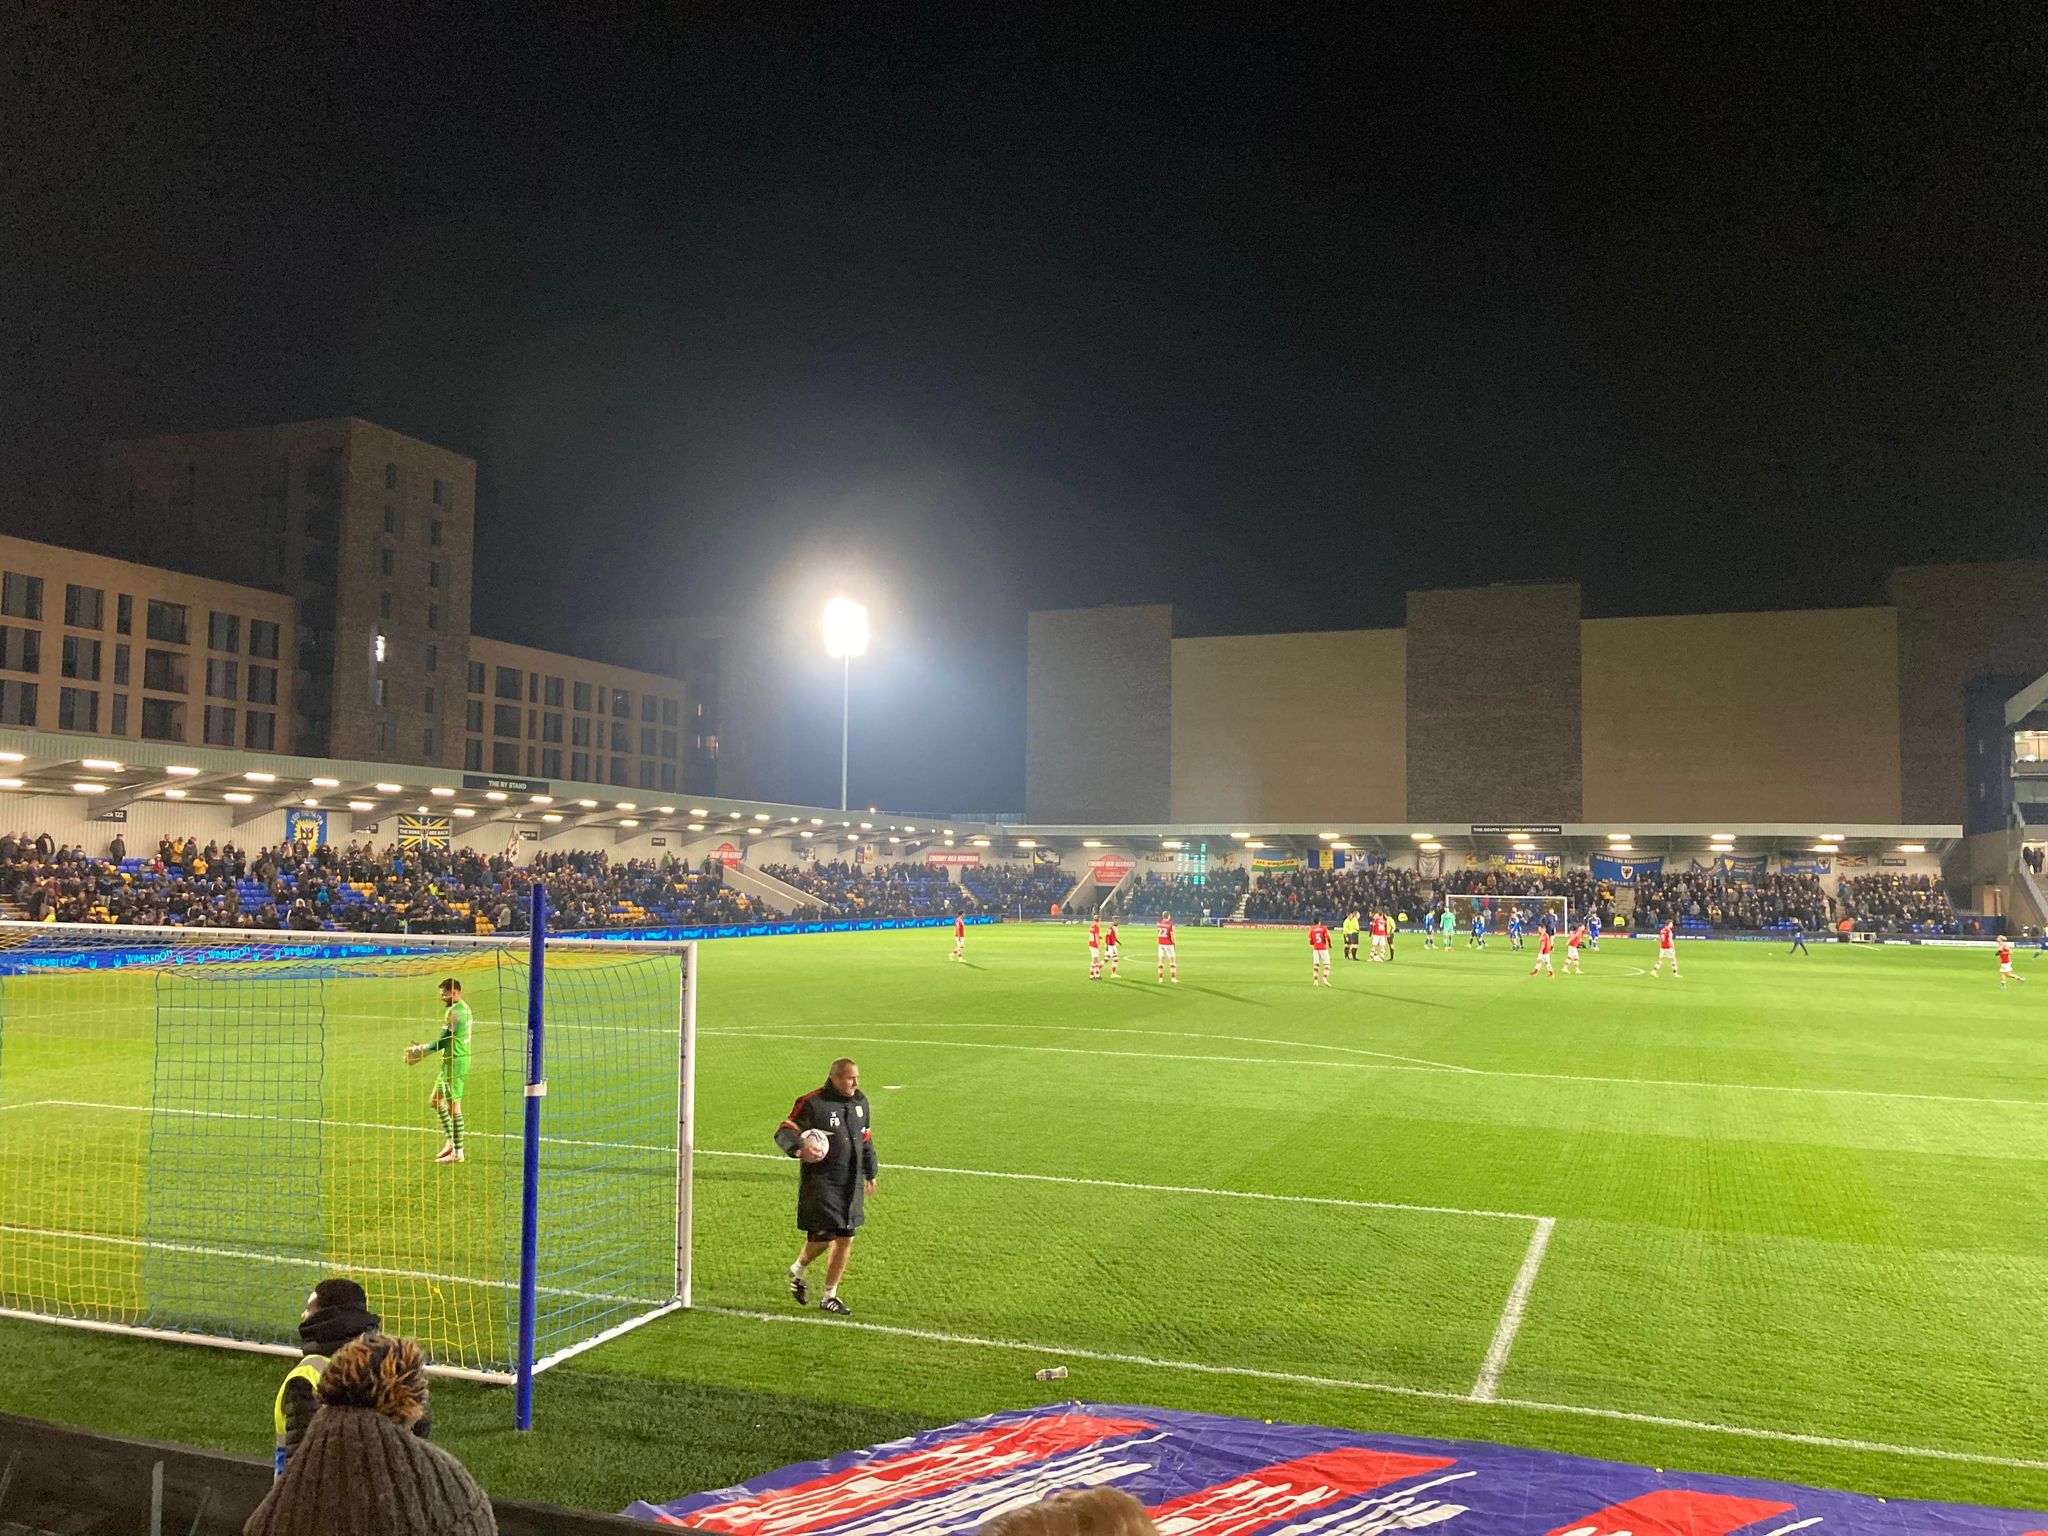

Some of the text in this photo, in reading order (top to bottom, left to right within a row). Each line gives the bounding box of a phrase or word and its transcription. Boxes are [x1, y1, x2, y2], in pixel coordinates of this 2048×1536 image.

[508, 782, 527, 790] STAND
[1158, 928, 1168, 937] 22
[1315, 933, 1322, 943] 5
[125, 949, 173, 964] WIMBLEDON
[208, 946, 251, 960] WIMBLEDON
